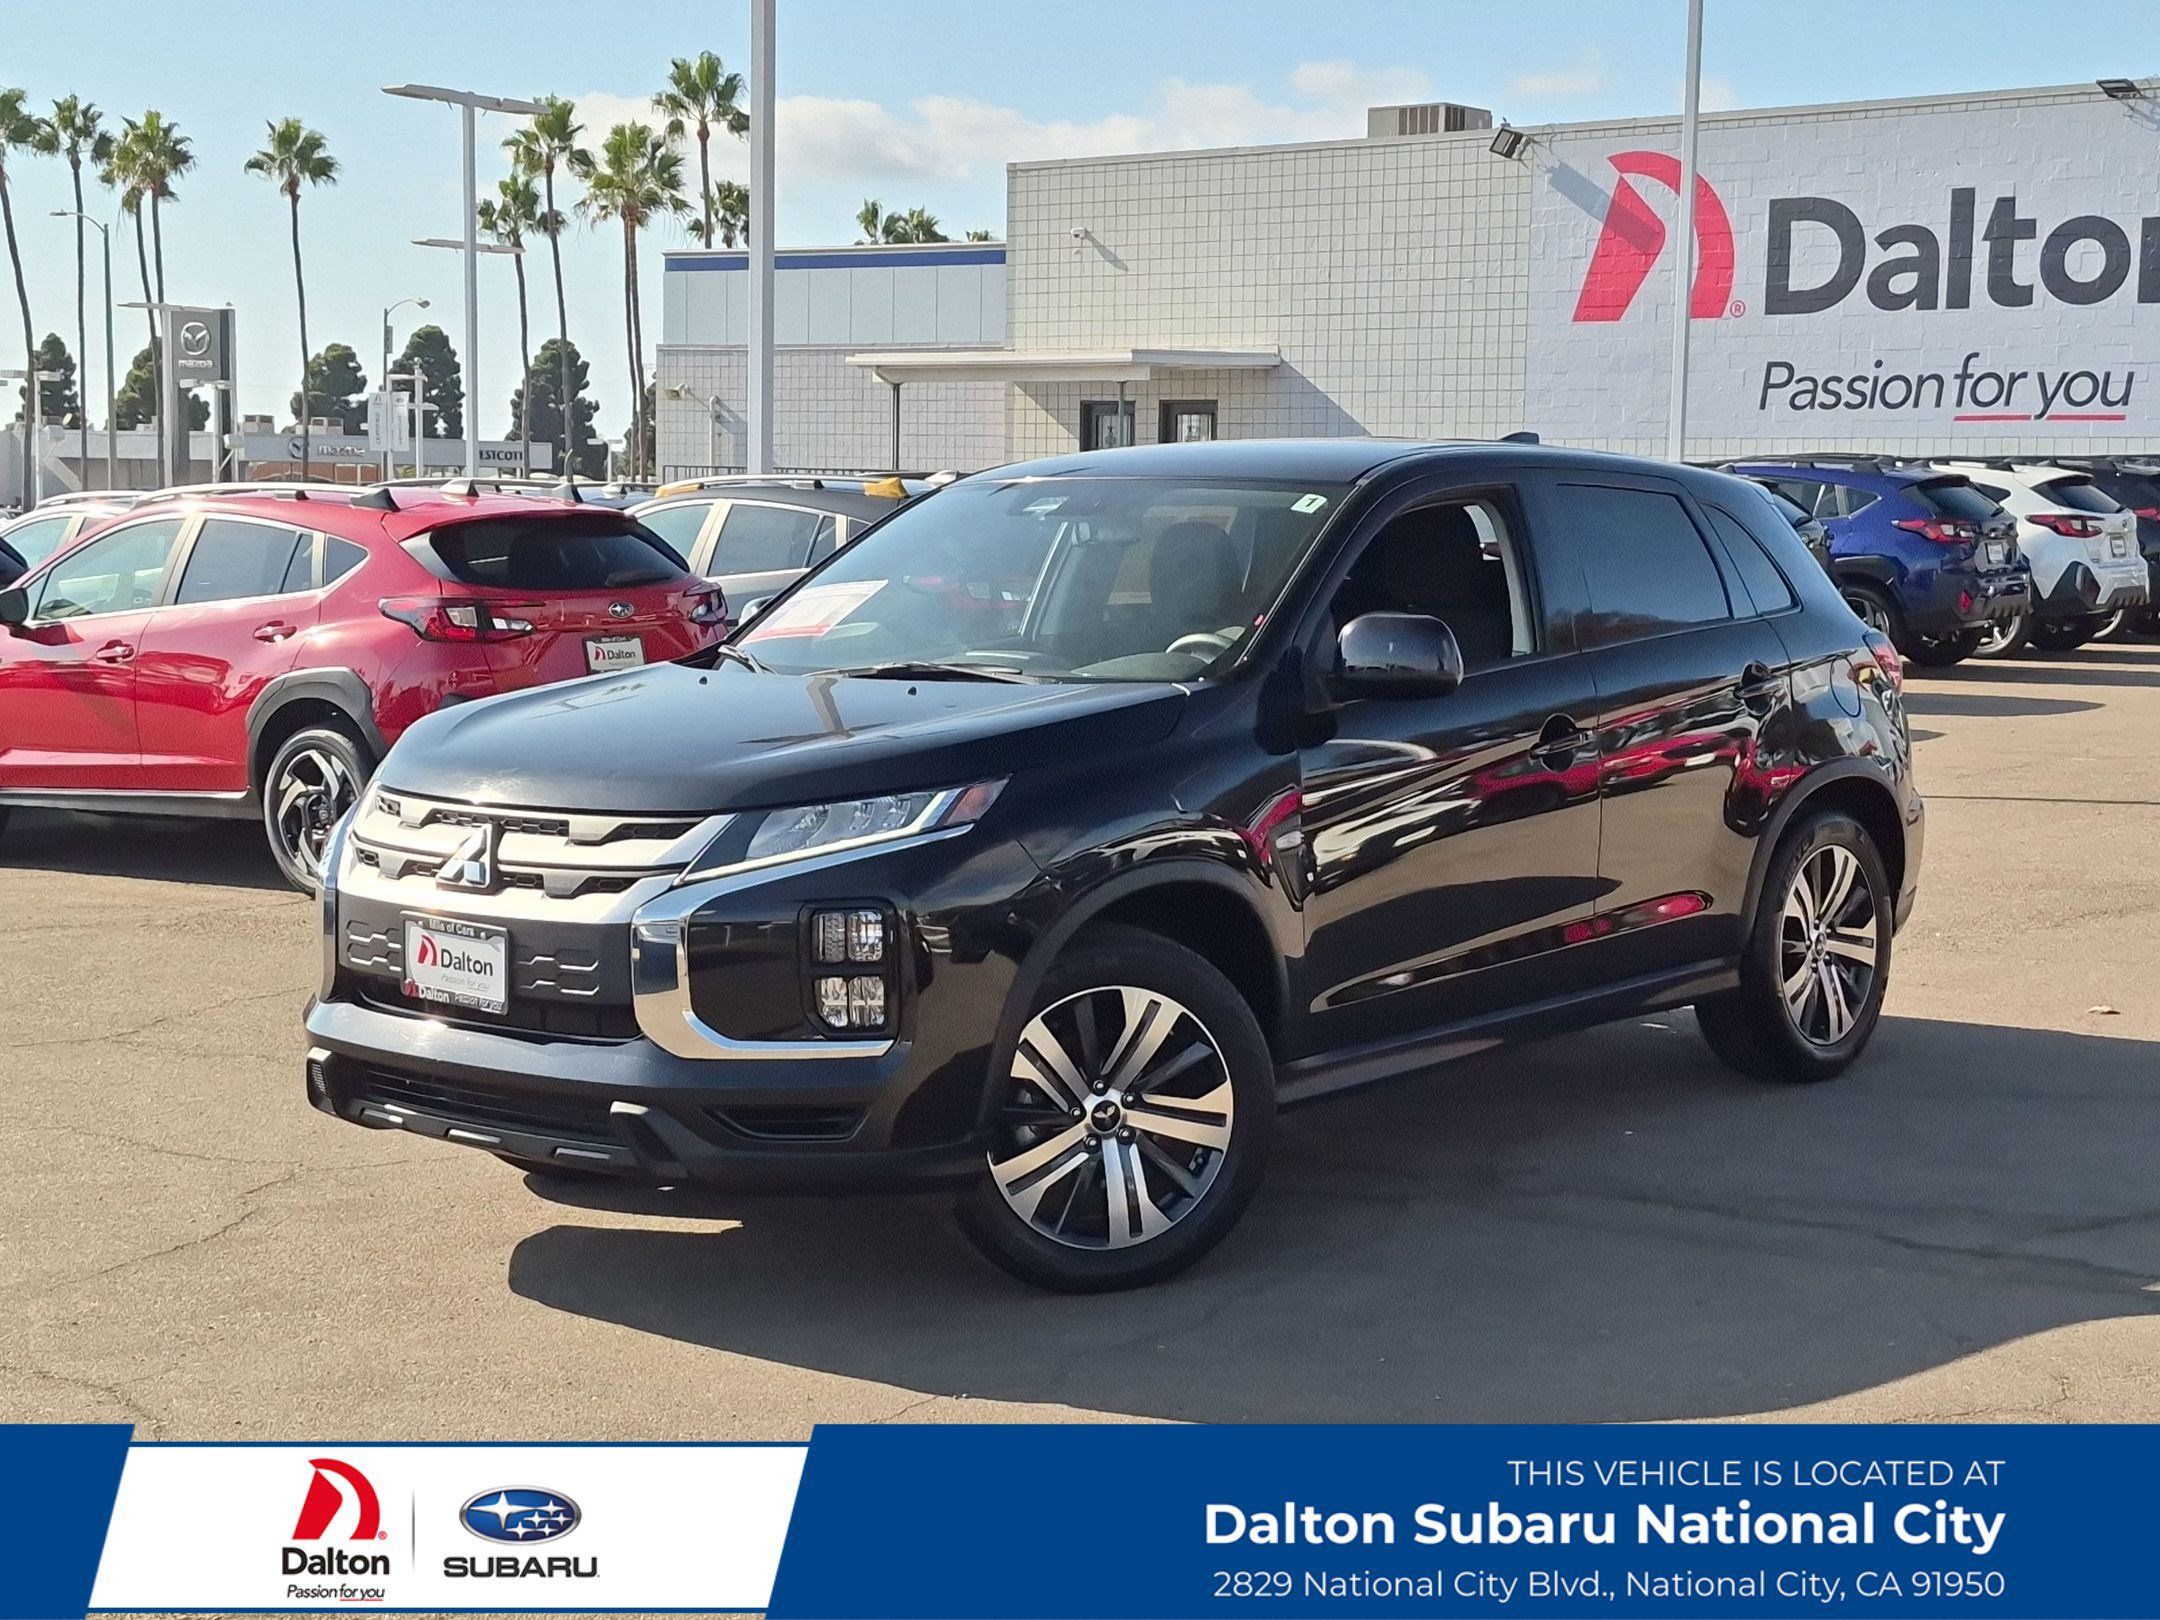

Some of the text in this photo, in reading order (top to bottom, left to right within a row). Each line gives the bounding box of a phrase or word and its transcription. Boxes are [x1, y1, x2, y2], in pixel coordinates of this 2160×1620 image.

[1765, 187, 2160, 316] Dalto
[1759, 352, 2135, 421] Passion for you
[1306, 497, 1319, 507] 1
[607, 649, 636, 660] Dalton
[441, 948, 493, 976] Dalton
[420, 986, 450, 1004] Dalton
